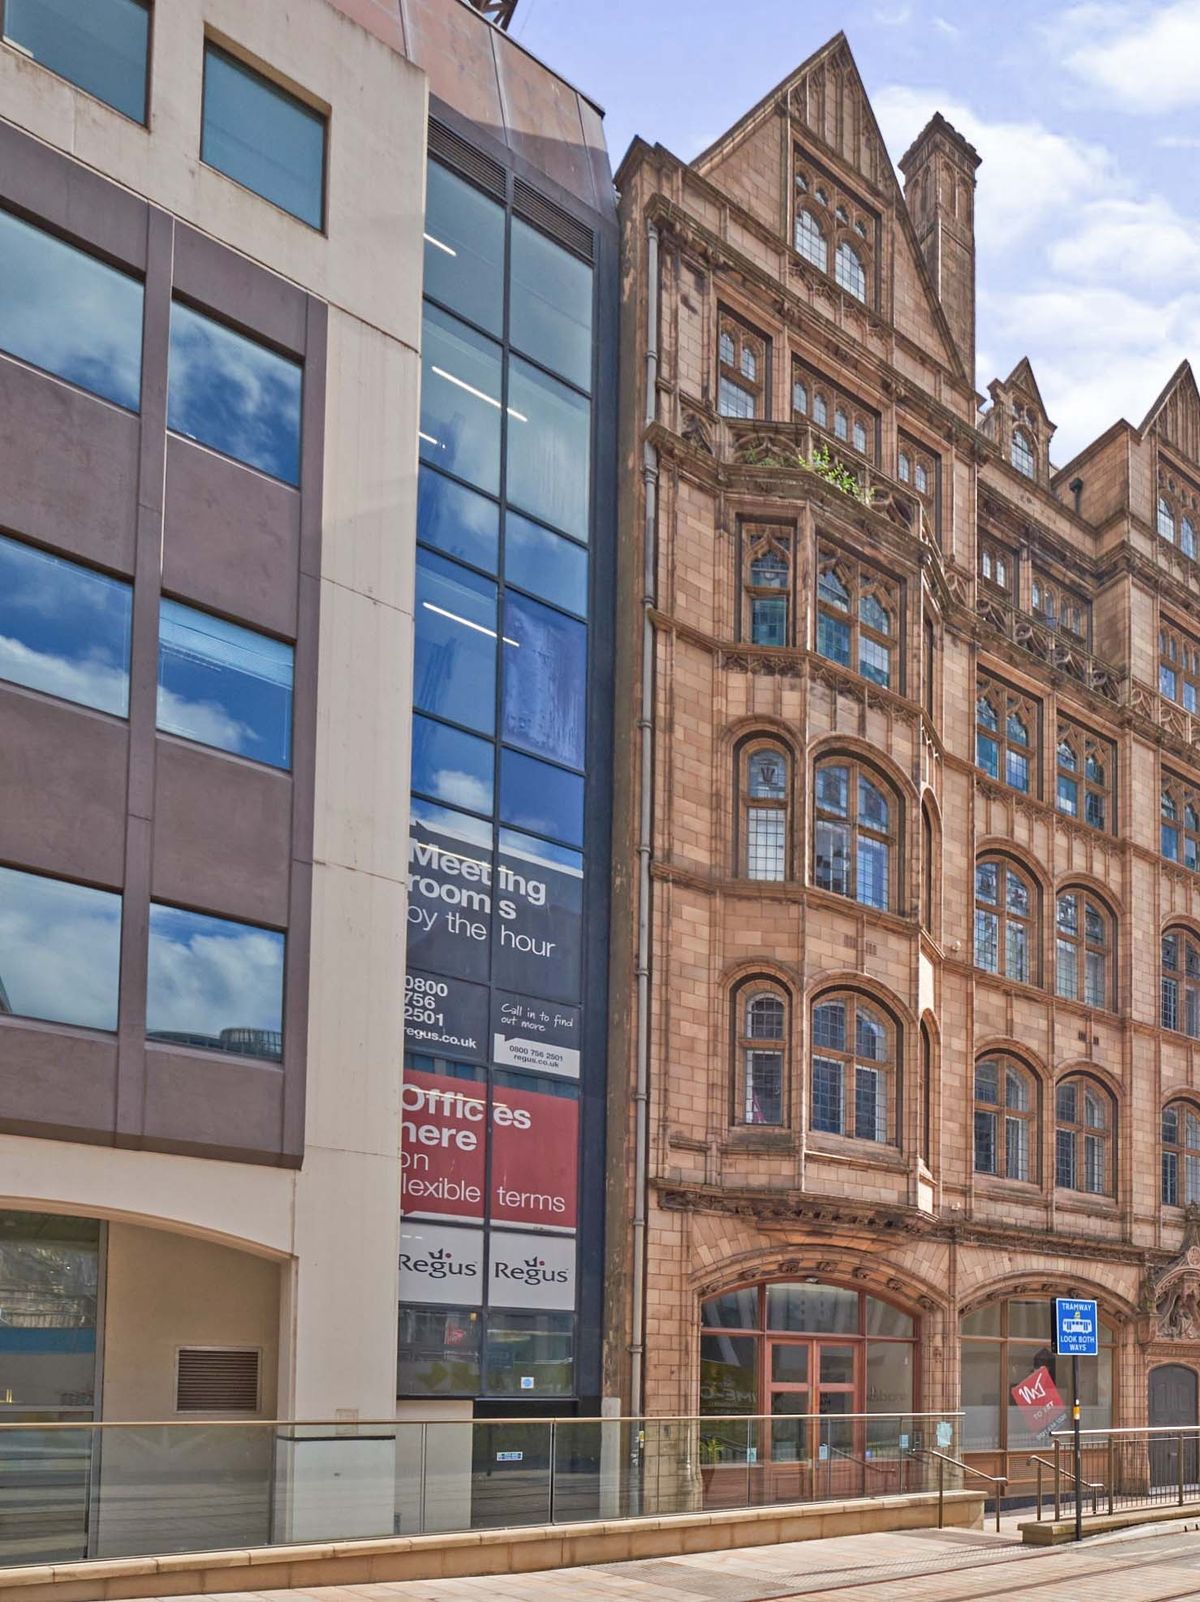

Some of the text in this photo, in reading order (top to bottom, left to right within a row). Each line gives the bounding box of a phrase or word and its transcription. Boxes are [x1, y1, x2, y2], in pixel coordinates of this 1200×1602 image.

[409, 837, 546, 906] Meeting
[408, 873, 517, 919] rooms
[445, 911, 487, 940] the
[501, 924, 556, 958] hour
[405, 975, 448, 997] 0800
[405, 991, 436, 1009] 756
[404, 1006, 444, 1027] 2501
[501, 1003, 573, 1028] Call in to find
[501, 1016, 546, 1031] out more
[509, 1045, 563, 1062] 0800 756 2501
[513, 1054, 559, 1068] regus.co.uk
[401, 1083, 532, 1129] Offices
[497, 1186, 566, 1213] terms
[399, 1253, 477, 1279] Regus
[495, 1262, 568, 1286] Regus
[1062, 1302, 1092, 1311] TRAMWAY
[1060, 1335, 1095, 1344] LOOK BOTH
